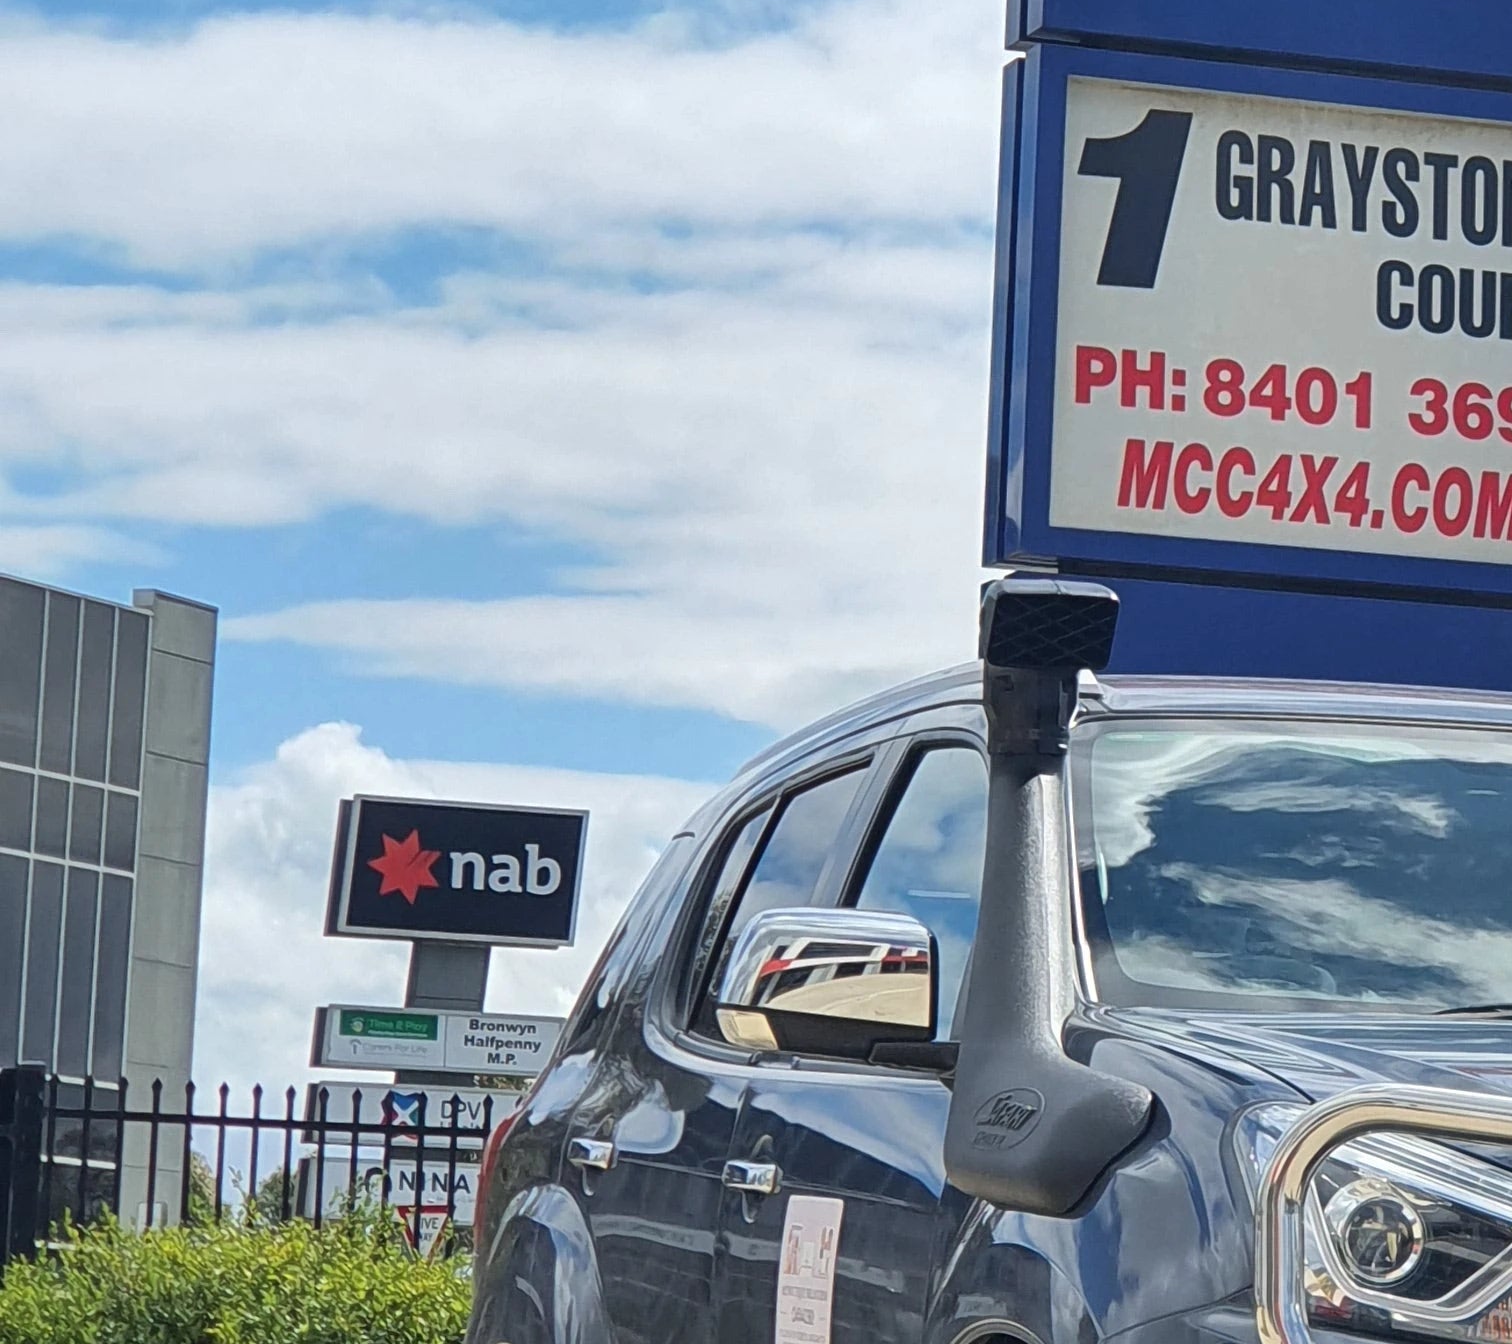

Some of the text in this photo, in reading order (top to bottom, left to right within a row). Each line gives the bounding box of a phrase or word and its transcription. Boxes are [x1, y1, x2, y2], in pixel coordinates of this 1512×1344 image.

[1076, 108, 1194, 289] 1
[1074, 344, 1188, 413] PH:
[1203, 357, 1374, 429] 8401
[448, 842, 562, 896] nab
[463, 1035, 542, 1054] Halfpenny
[468, 1018, 537, 1035] Bronwyn
[487, 1053, 518, 1066] M.P.
